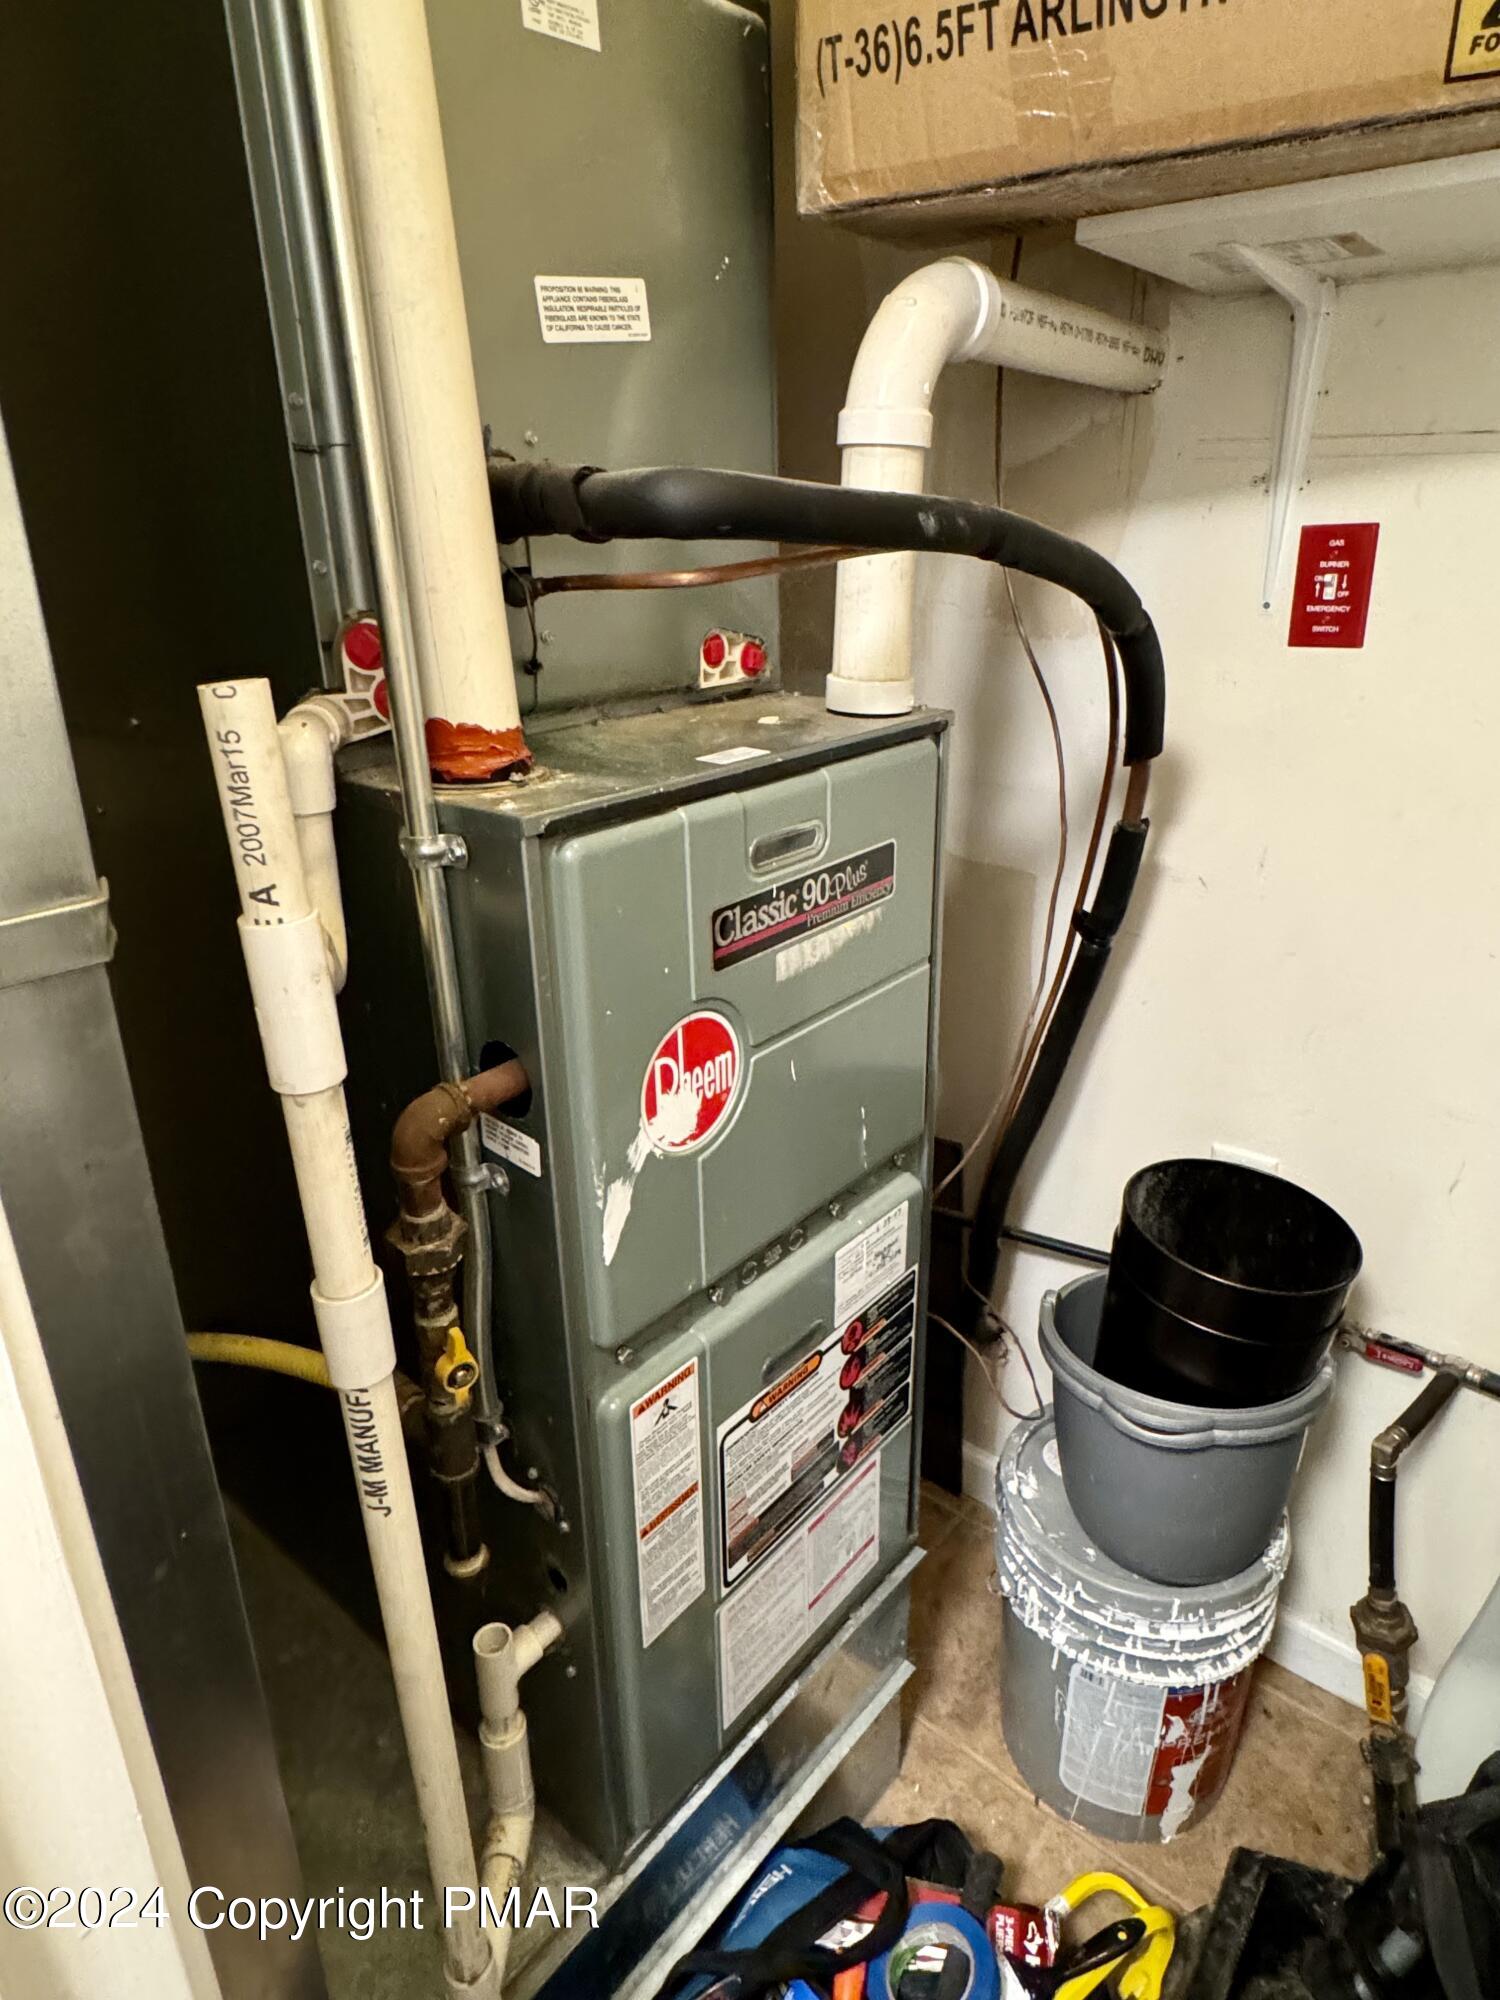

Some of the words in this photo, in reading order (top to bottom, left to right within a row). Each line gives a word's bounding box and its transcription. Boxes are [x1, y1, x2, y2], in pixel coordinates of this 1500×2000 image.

[816, 2, 1000, 98] (T-36)6.5FT
[1328, 539, 1345, 547] GAS
[1319, 560, 1350, 568] BURNER
[1306, 605, 1351, 613] EMERGENCY
[1311, 625, 1340, 633] SWITCH
[713, 892, 800, 947] Classic
[768, 1364, 811, 1403] WARNING
[362, 1479, 392, 1518] J-M
